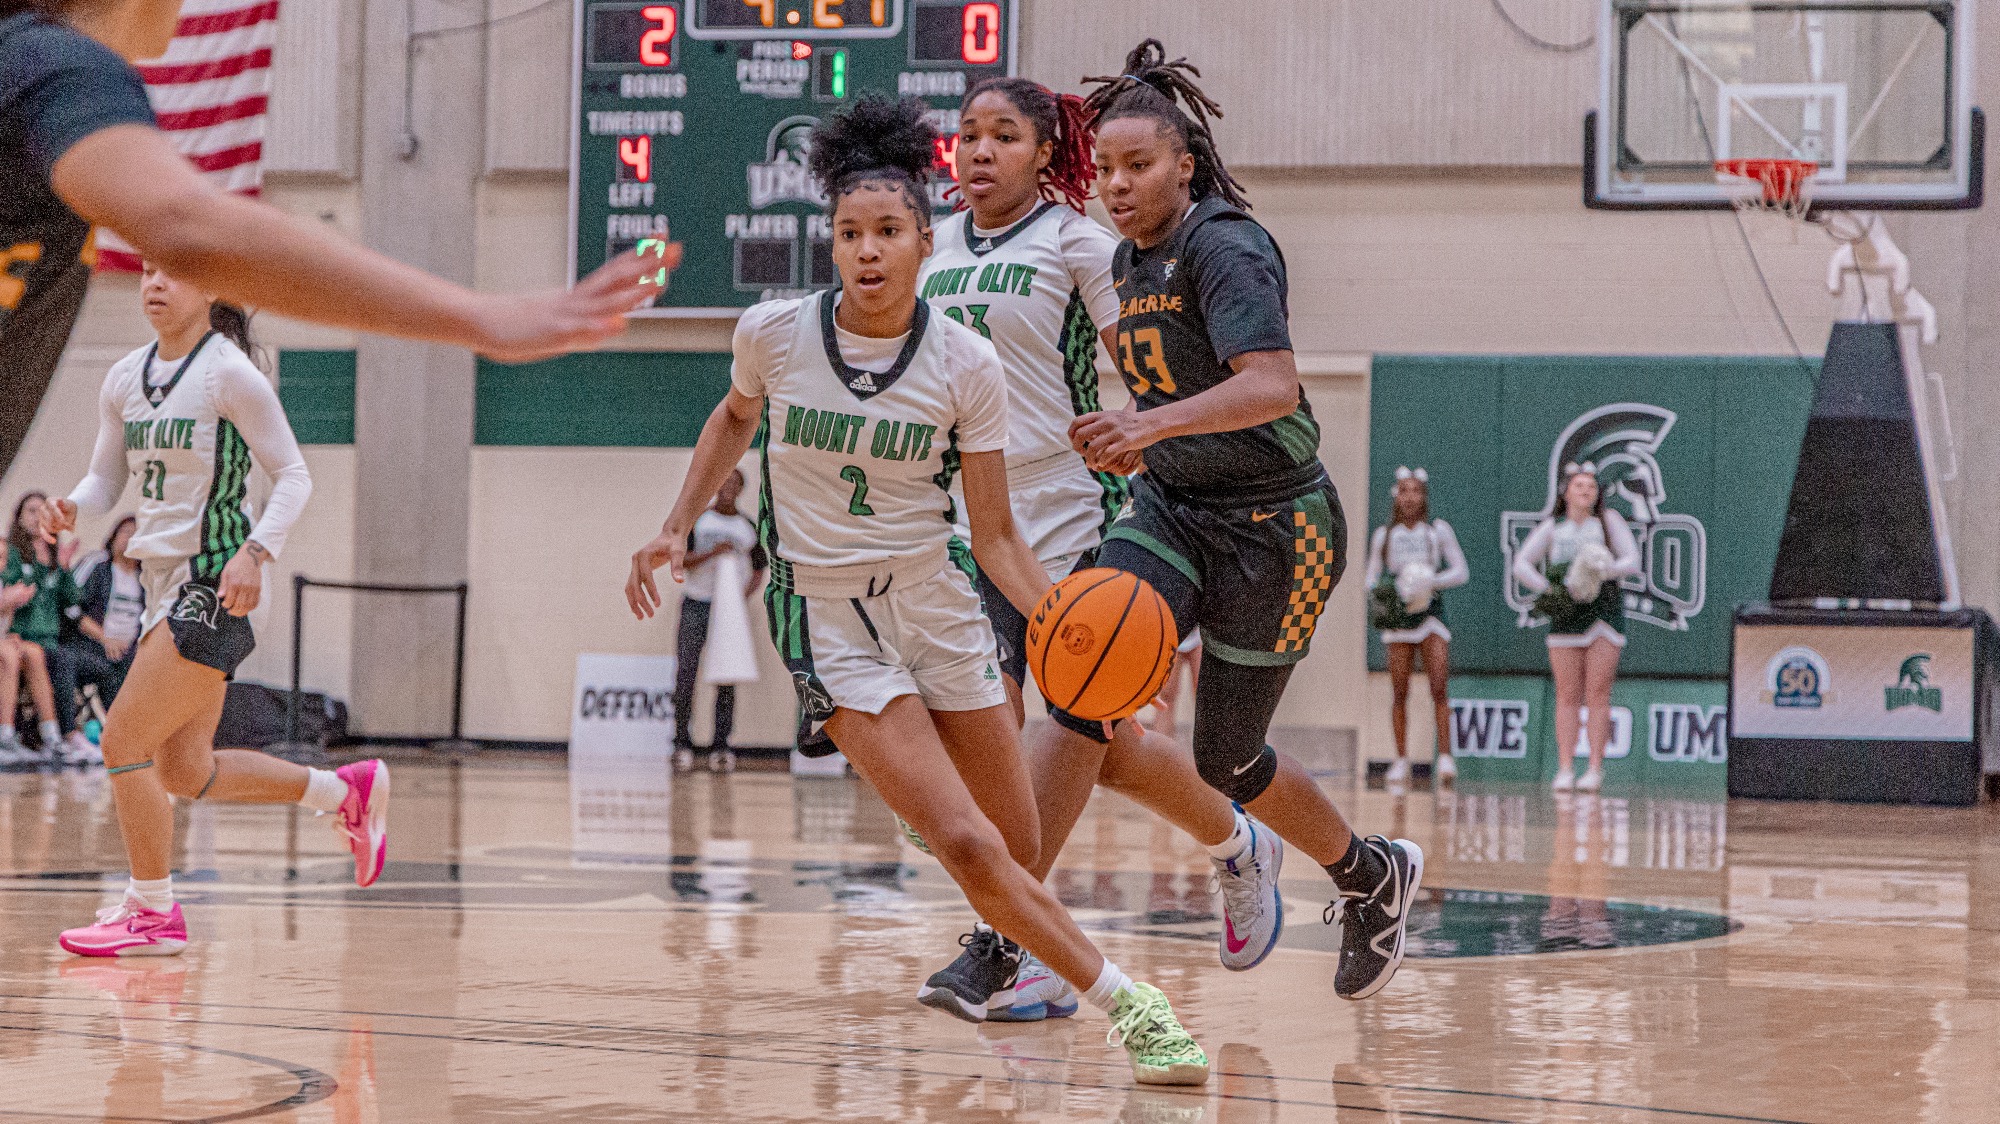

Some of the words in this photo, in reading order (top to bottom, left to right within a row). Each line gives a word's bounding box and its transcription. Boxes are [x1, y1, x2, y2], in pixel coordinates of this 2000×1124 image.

[640, 6, 676, 66] 2
[962, 2, 1000, 64] 0
[621, 73, 688, 98] BONUS
[736, 59, 809, 82] PERIOD
[832, 51, 845, 98] 1
[898, 71, 966, 96] BONUS
[587, 110, 684, 136] TIMEOUTS
[619, 134, 651, 182] 4
[608, 182, 657, 208] LEFT
[607, 213, 669, 239] FOULS
[725, 214, 799, 240] PLAYER
[977, 262, 1038, 297] OLIVE
[1118, 327, 1177, 396] 33
[849, 381, 877, 393] adidas
[154, 417, 196, 450] OLIVE
[782, 404, 867, 455] MOUNT
[870, 418, 938, 462] OLIVE
[839, 464, 876, 517] 2
[1451, 702, 1527, 756] WE
